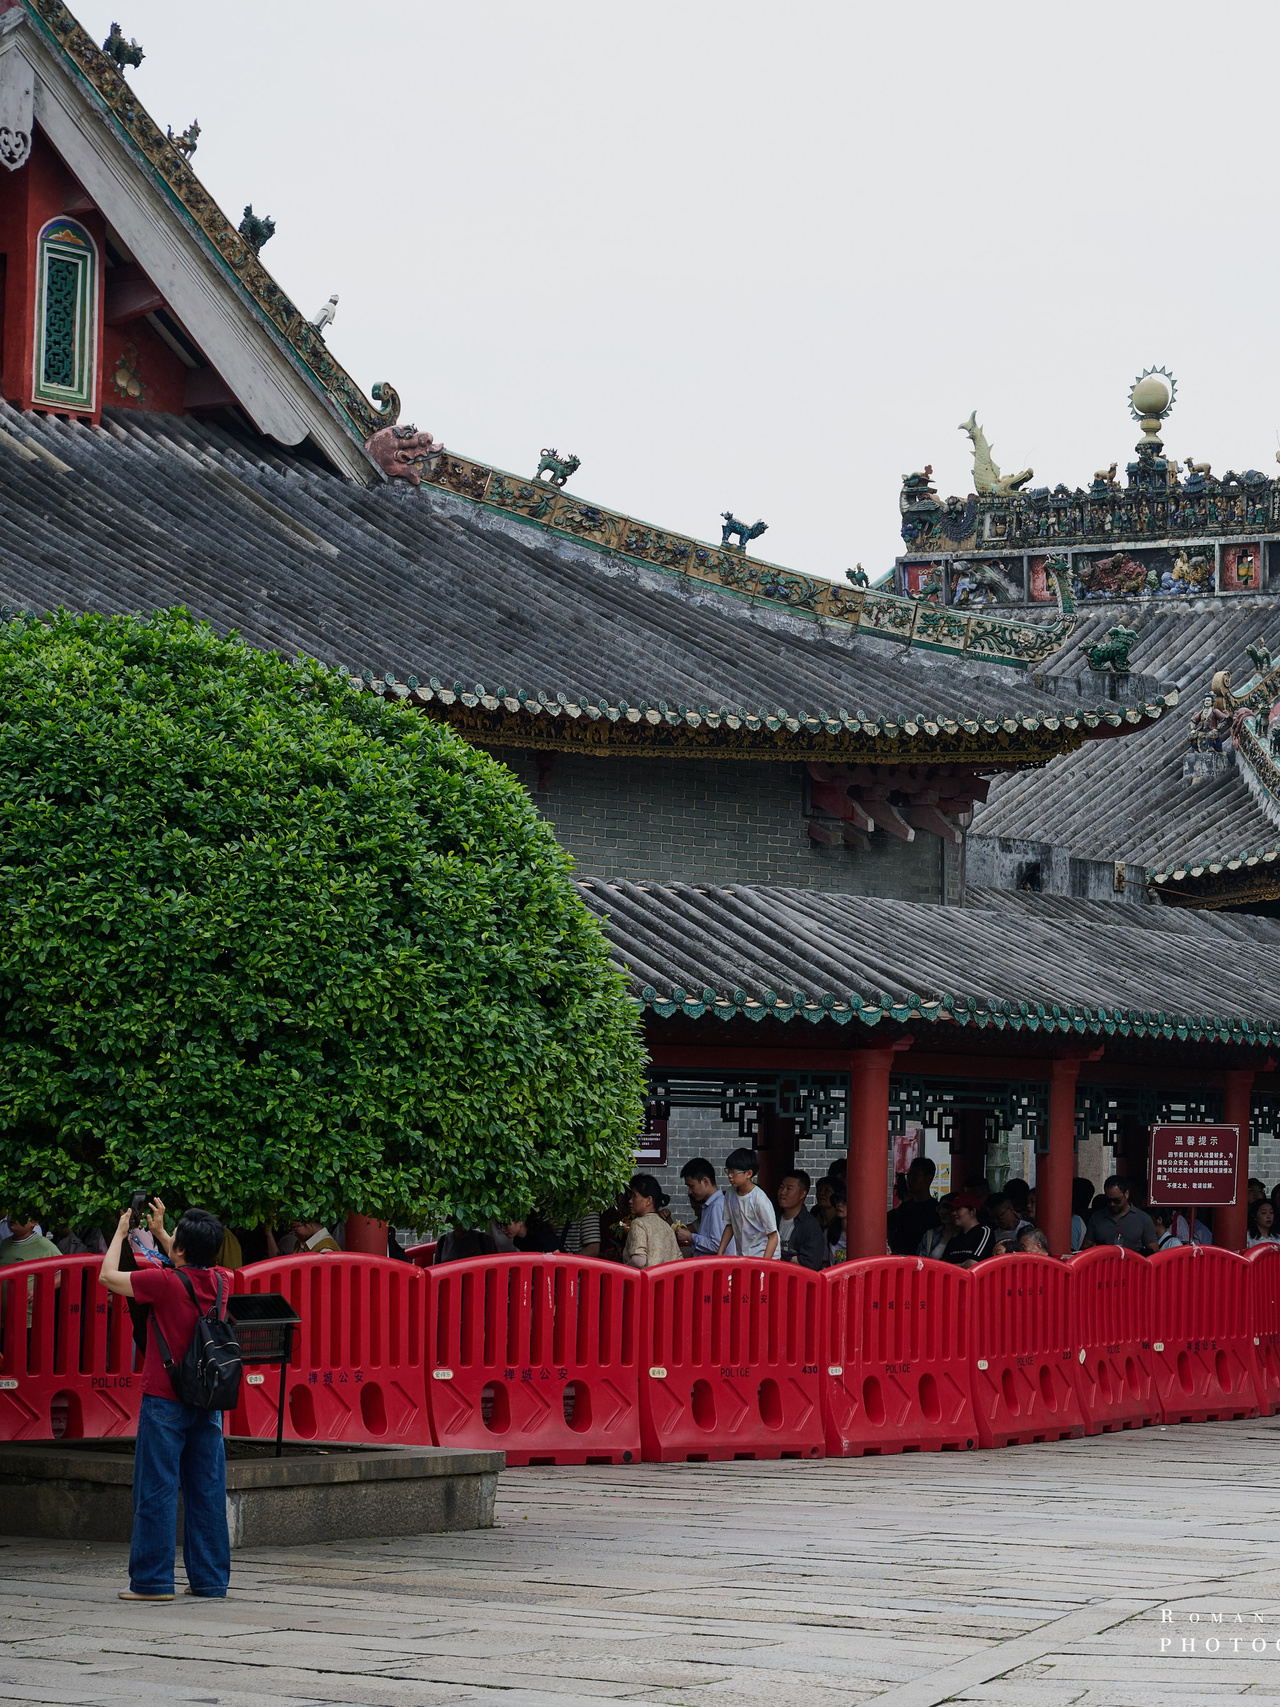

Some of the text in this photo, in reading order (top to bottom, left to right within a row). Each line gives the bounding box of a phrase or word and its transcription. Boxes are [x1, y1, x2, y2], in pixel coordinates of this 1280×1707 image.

[1174, 1135, 1219, 1146] 温馨提示
[720, 1367, 750, 1378] POLICE
[801, 1365, 818, 1374] 430
[886, 1363, 911, 1374] POLICE
[308, 1370, 364, 1384] 禅城公安
[504, 1368, 568, 1381] 禅城公安
[91, 1377, 133, 1388] POLICE
